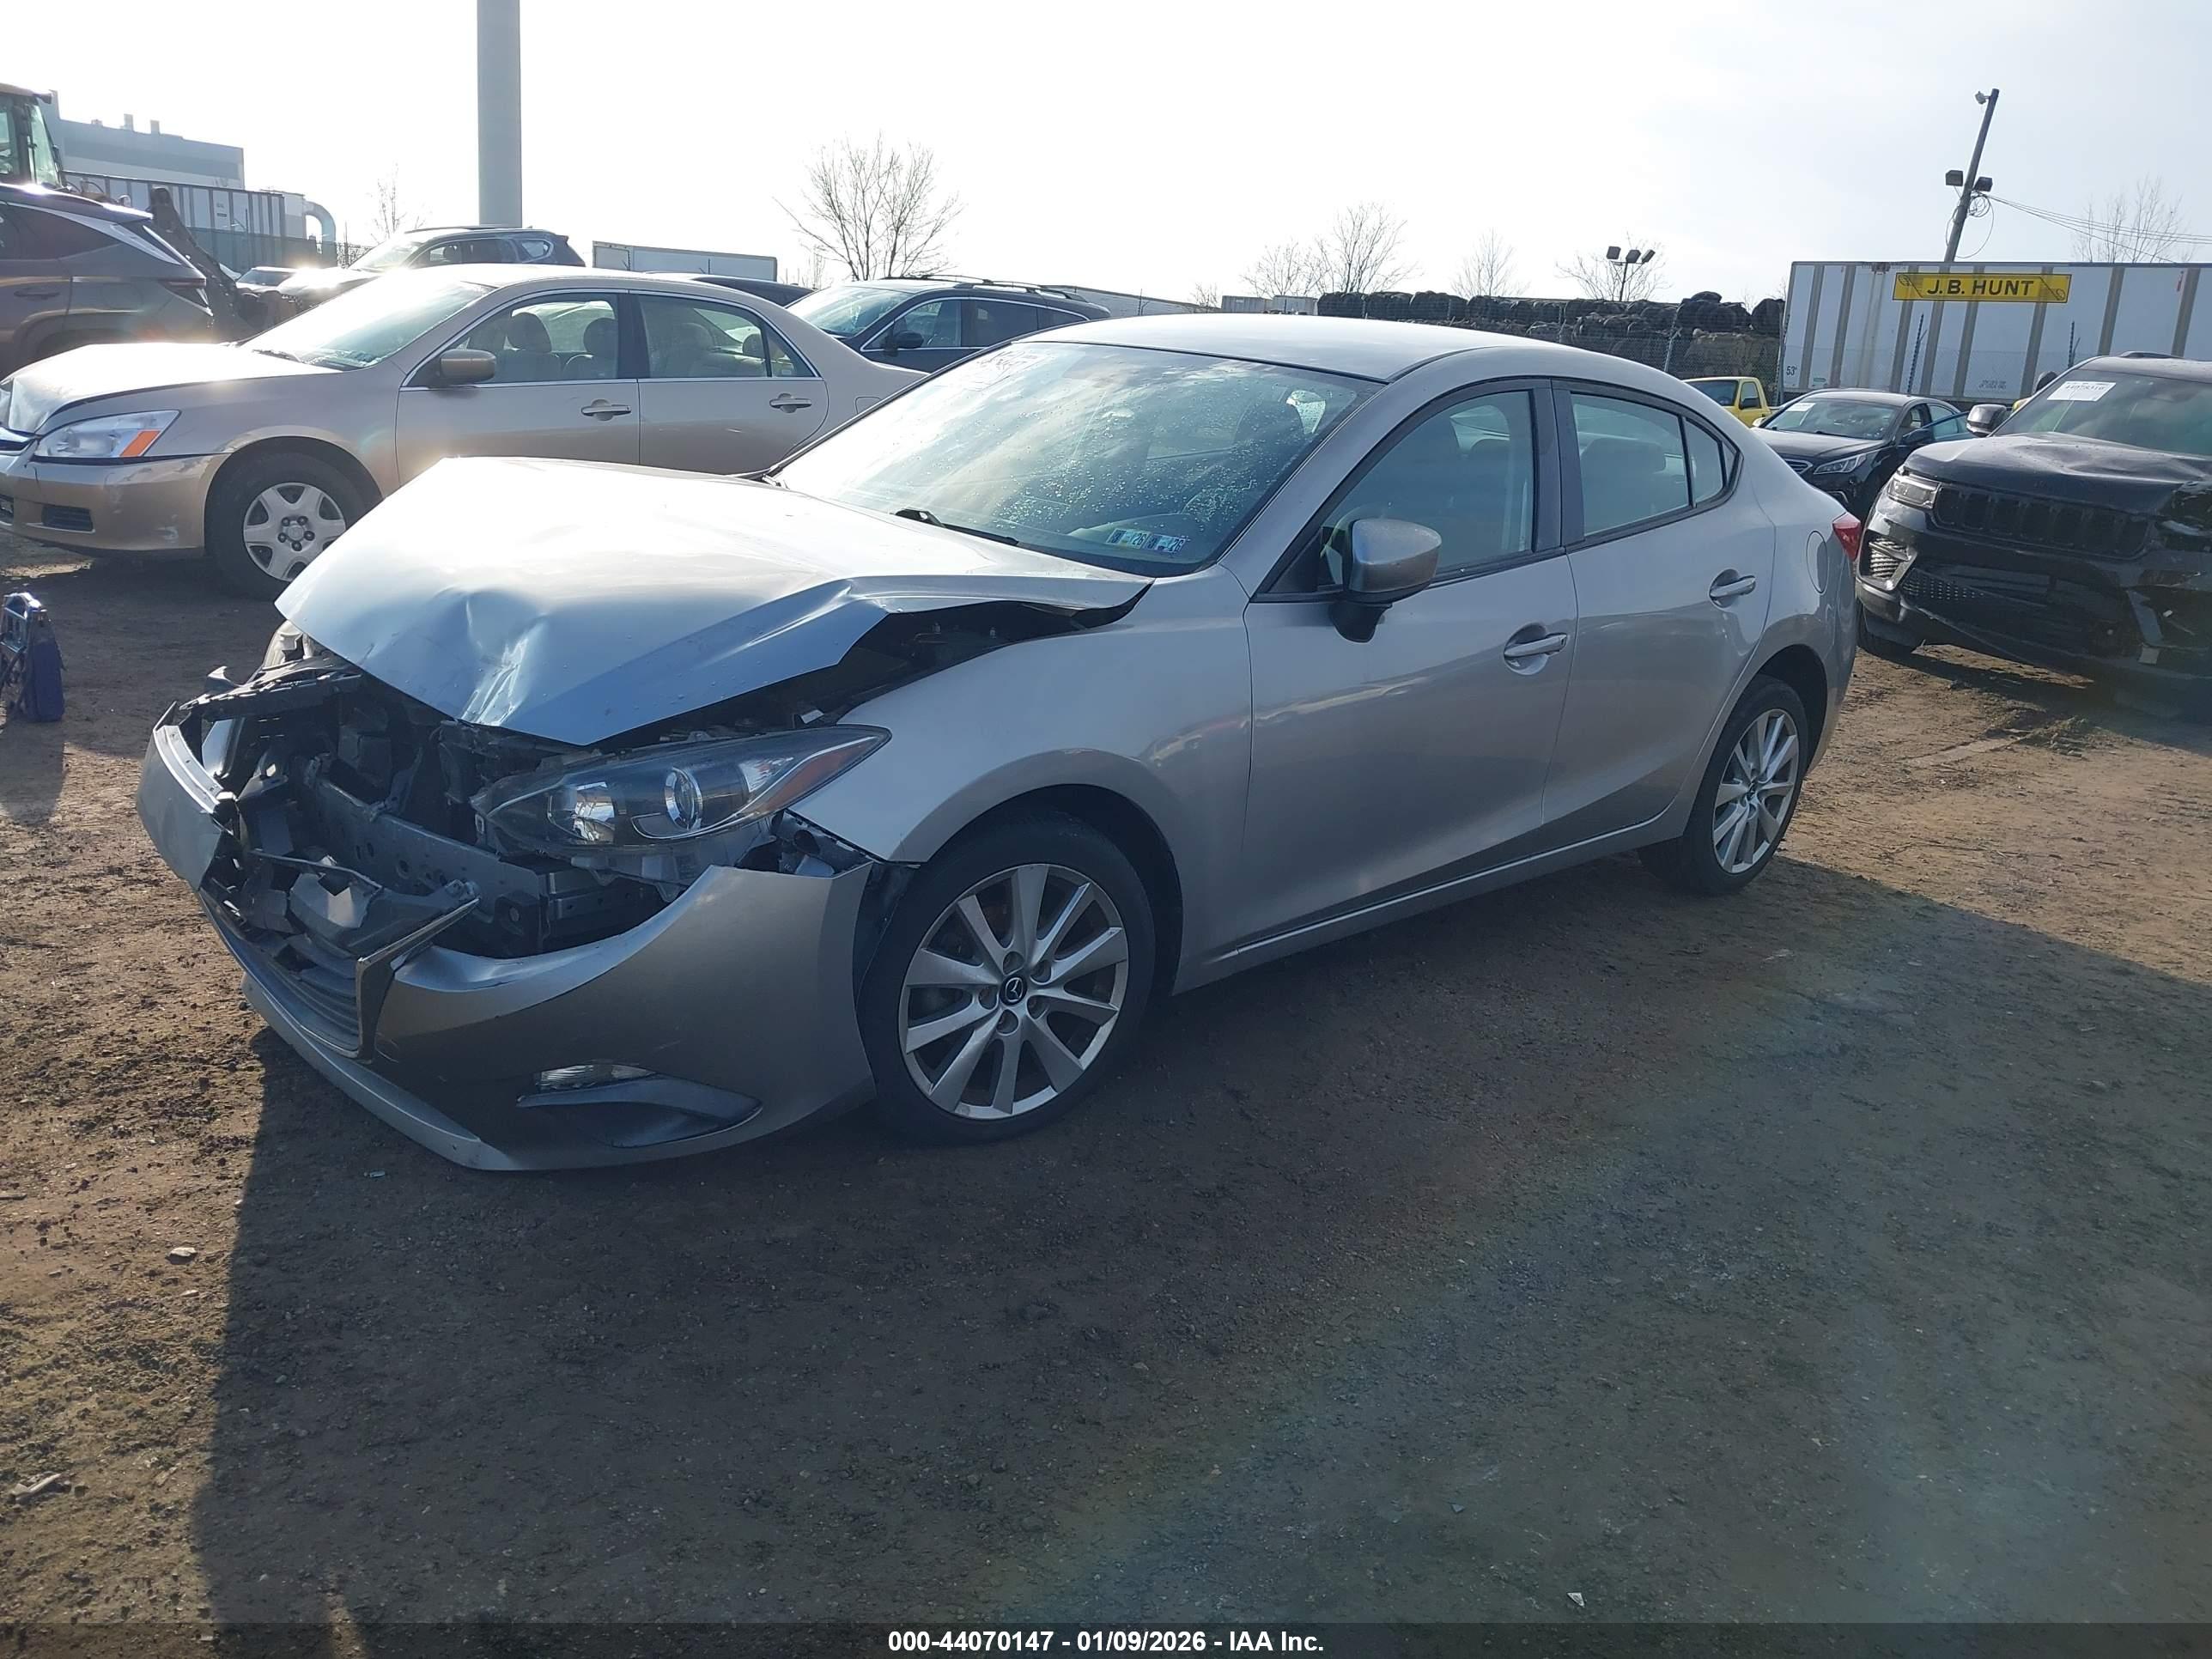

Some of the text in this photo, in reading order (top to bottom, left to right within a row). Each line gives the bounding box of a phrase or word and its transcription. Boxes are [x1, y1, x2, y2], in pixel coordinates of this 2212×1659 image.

[1972, 280, 2033, 296] HUNT
[1132, 532, 1147, 546] 26
[1168, 538, 1185, 551] 26
